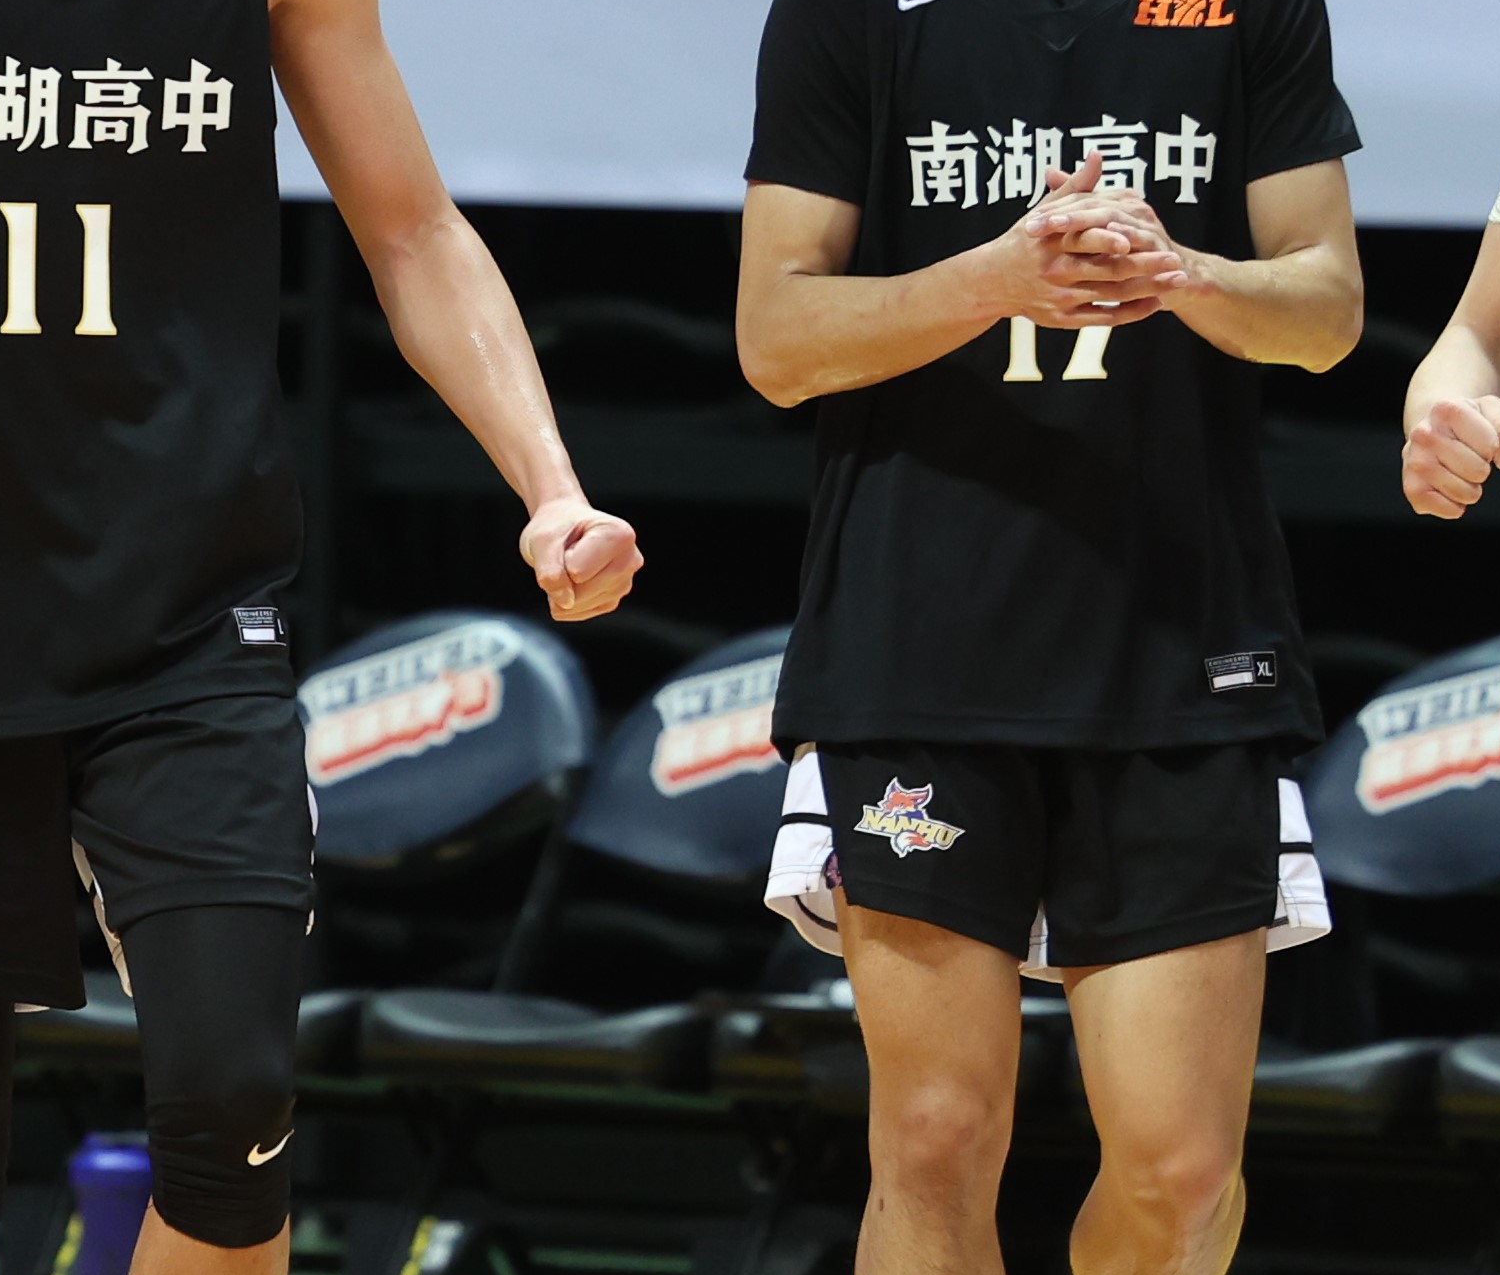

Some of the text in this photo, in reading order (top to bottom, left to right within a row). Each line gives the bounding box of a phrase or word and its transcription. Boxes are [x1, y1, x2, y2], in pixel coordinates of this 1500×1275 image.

[906, 113, 1217, 209] 南湖高中
[1257, 661, 1273, 677] XL
[862, 807, 956, 847] NANHU
